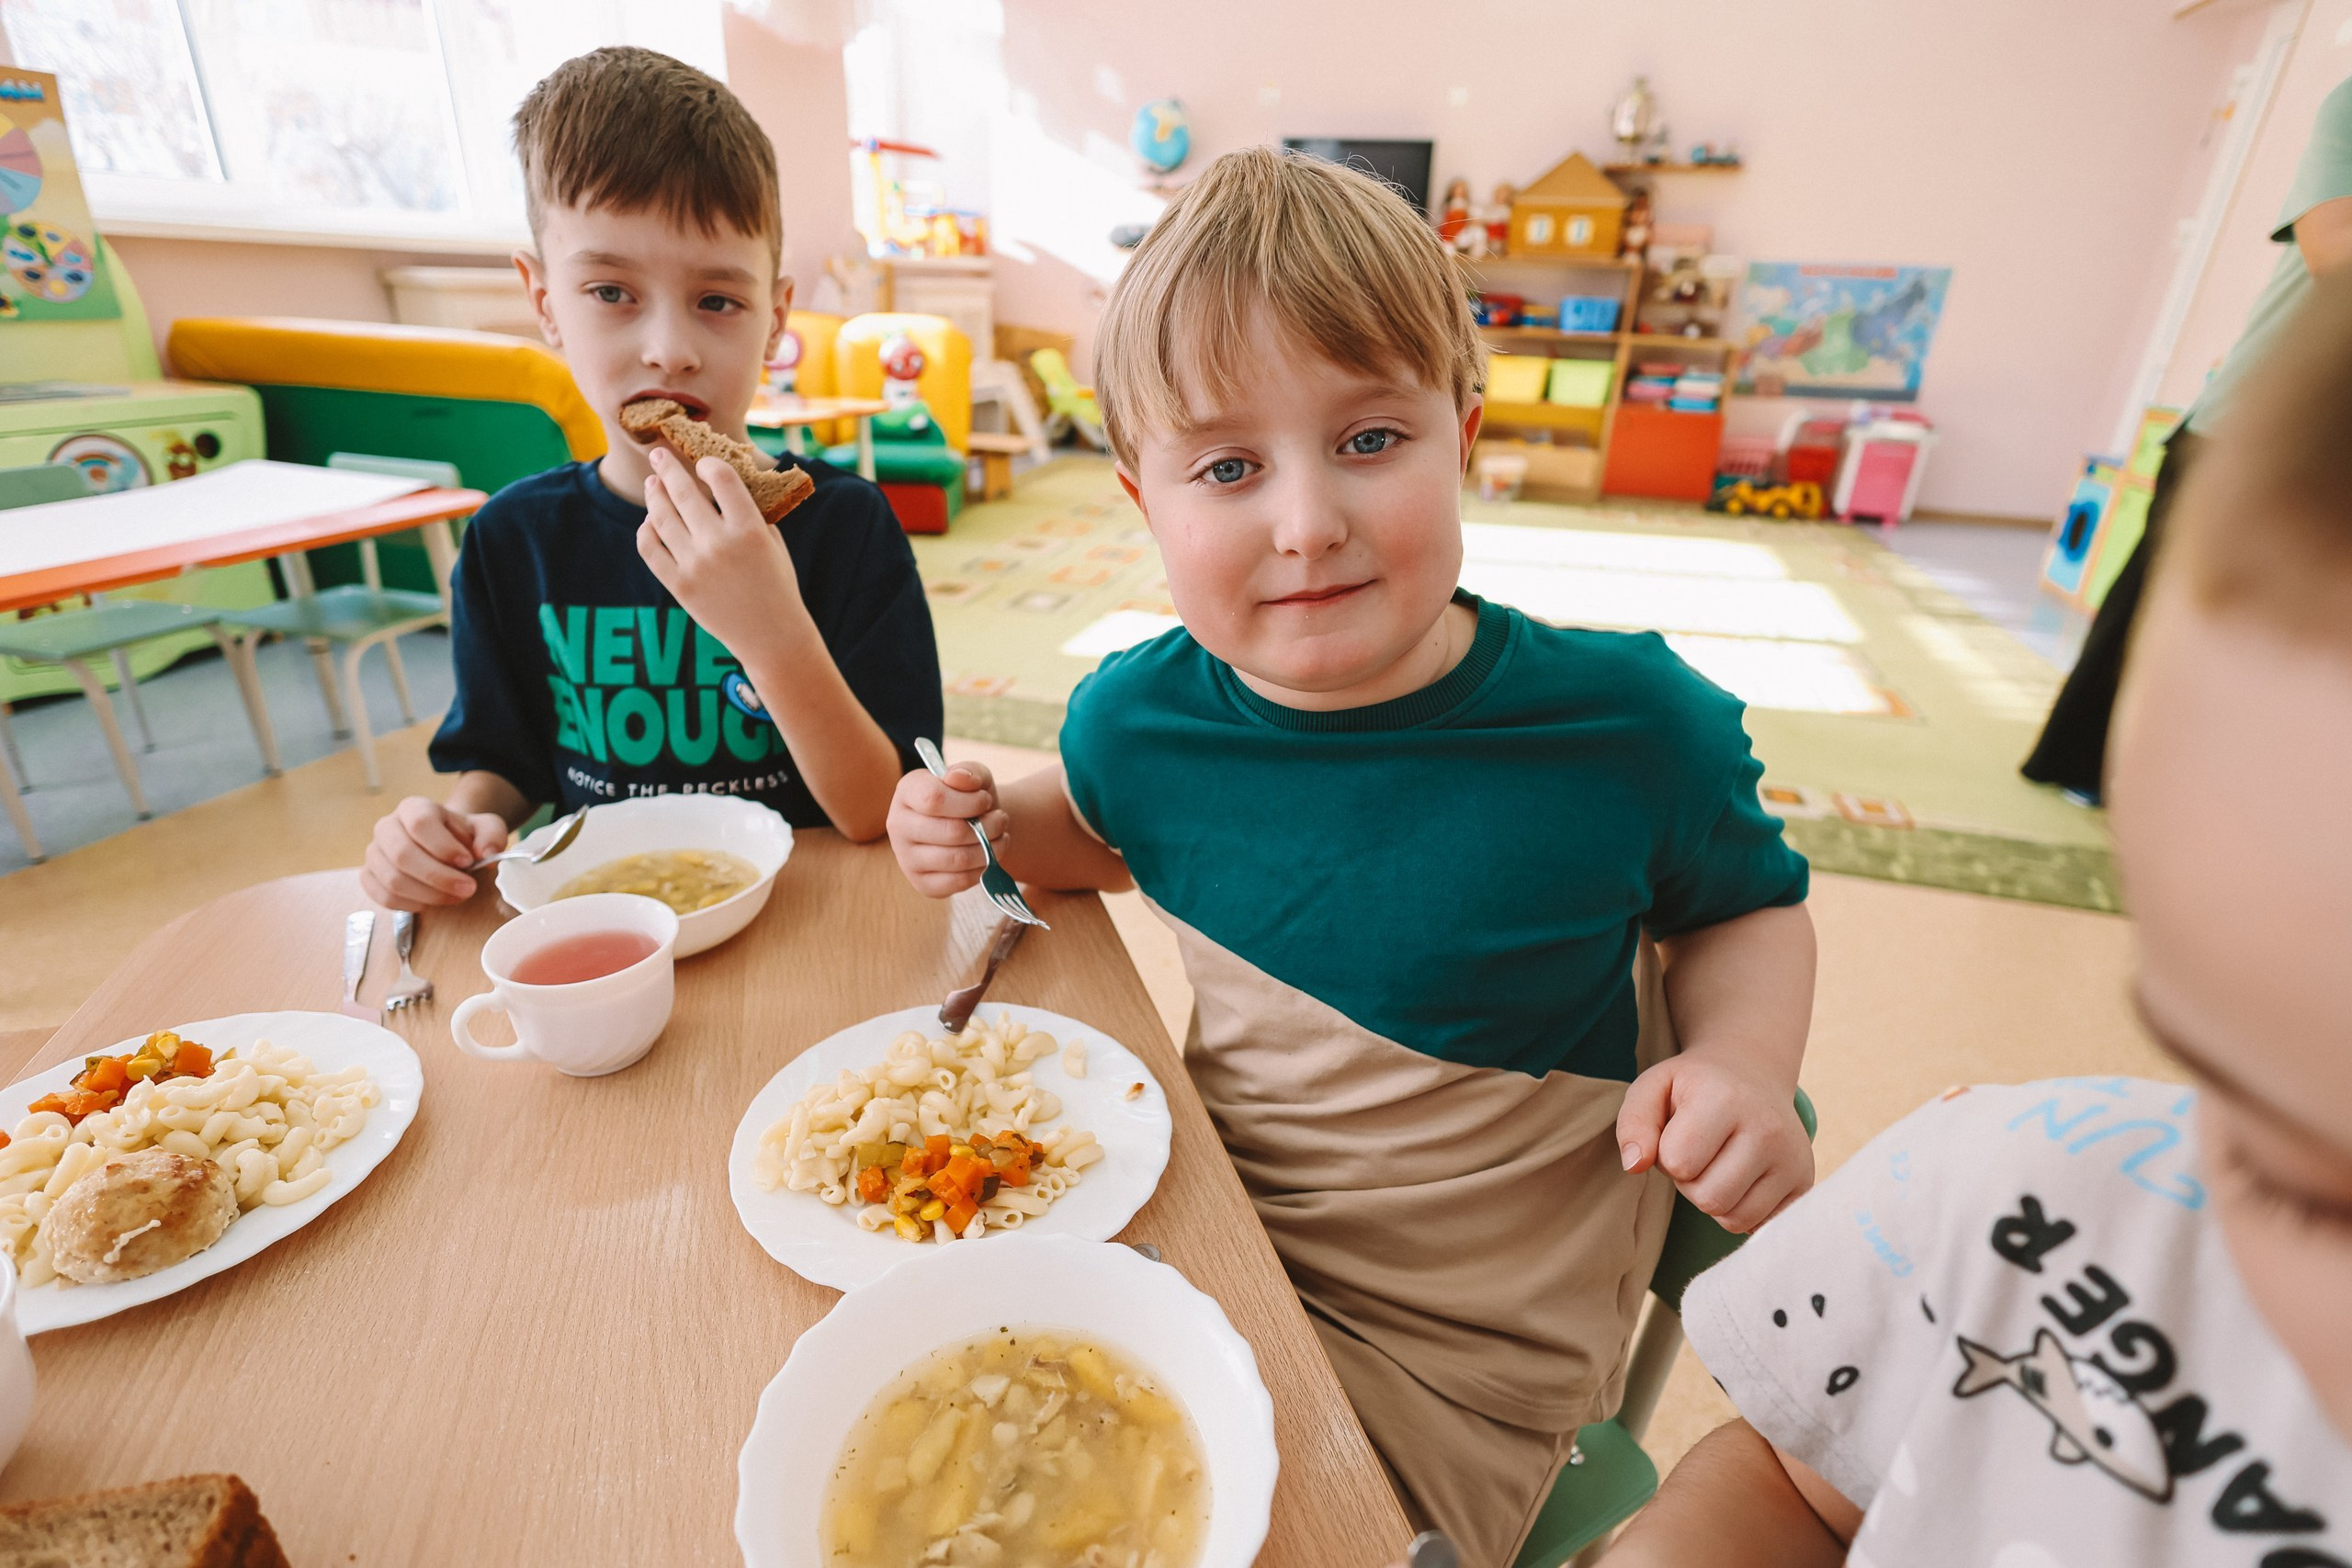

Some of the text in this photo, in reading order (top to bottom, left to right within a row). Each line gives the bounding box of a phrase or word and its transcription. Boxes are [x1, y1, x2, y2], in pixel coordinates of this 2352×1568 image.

[538, 603, 749, 686] NEVE
[547, 673, 787, 766] ENOUG
[567, 766, 788, 797] NOTICE THE RECKLESS
[1991, 1194, 2352, 1568] ANGER
